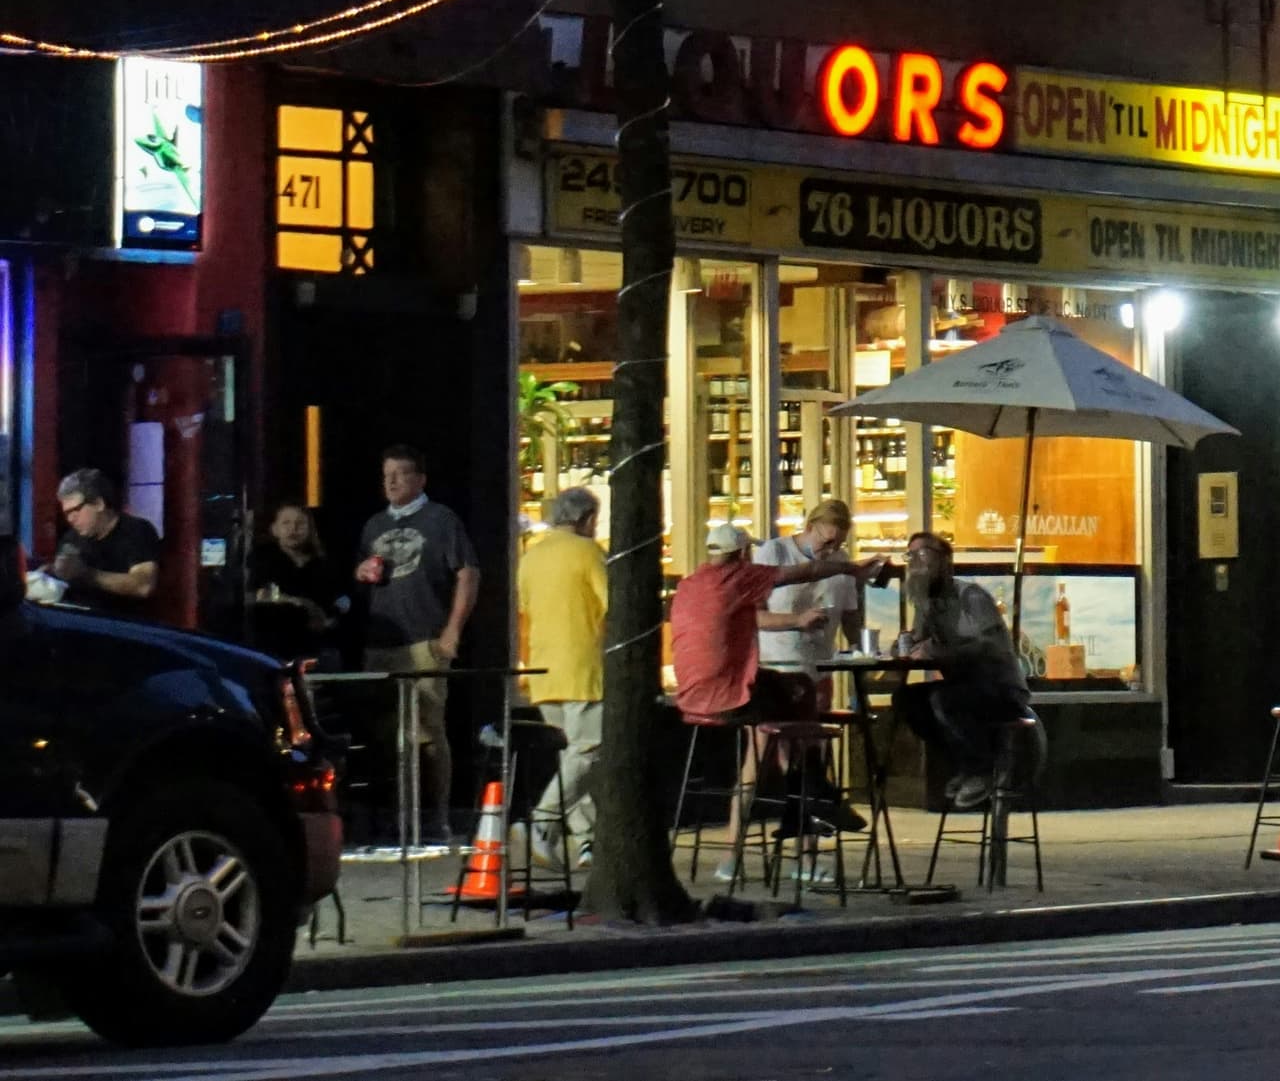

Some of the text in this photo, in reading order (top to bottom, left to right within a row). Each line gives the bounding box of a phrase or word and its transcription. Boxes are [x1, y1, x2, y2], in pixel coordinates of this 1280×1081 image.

[1021, 81, 1106, 144] OPEN
[279, 174, 321, 209] 471
[806, 191, 1037, 251] 76 LIQUORS
[1090, 217, 1146, 260] OPEN
